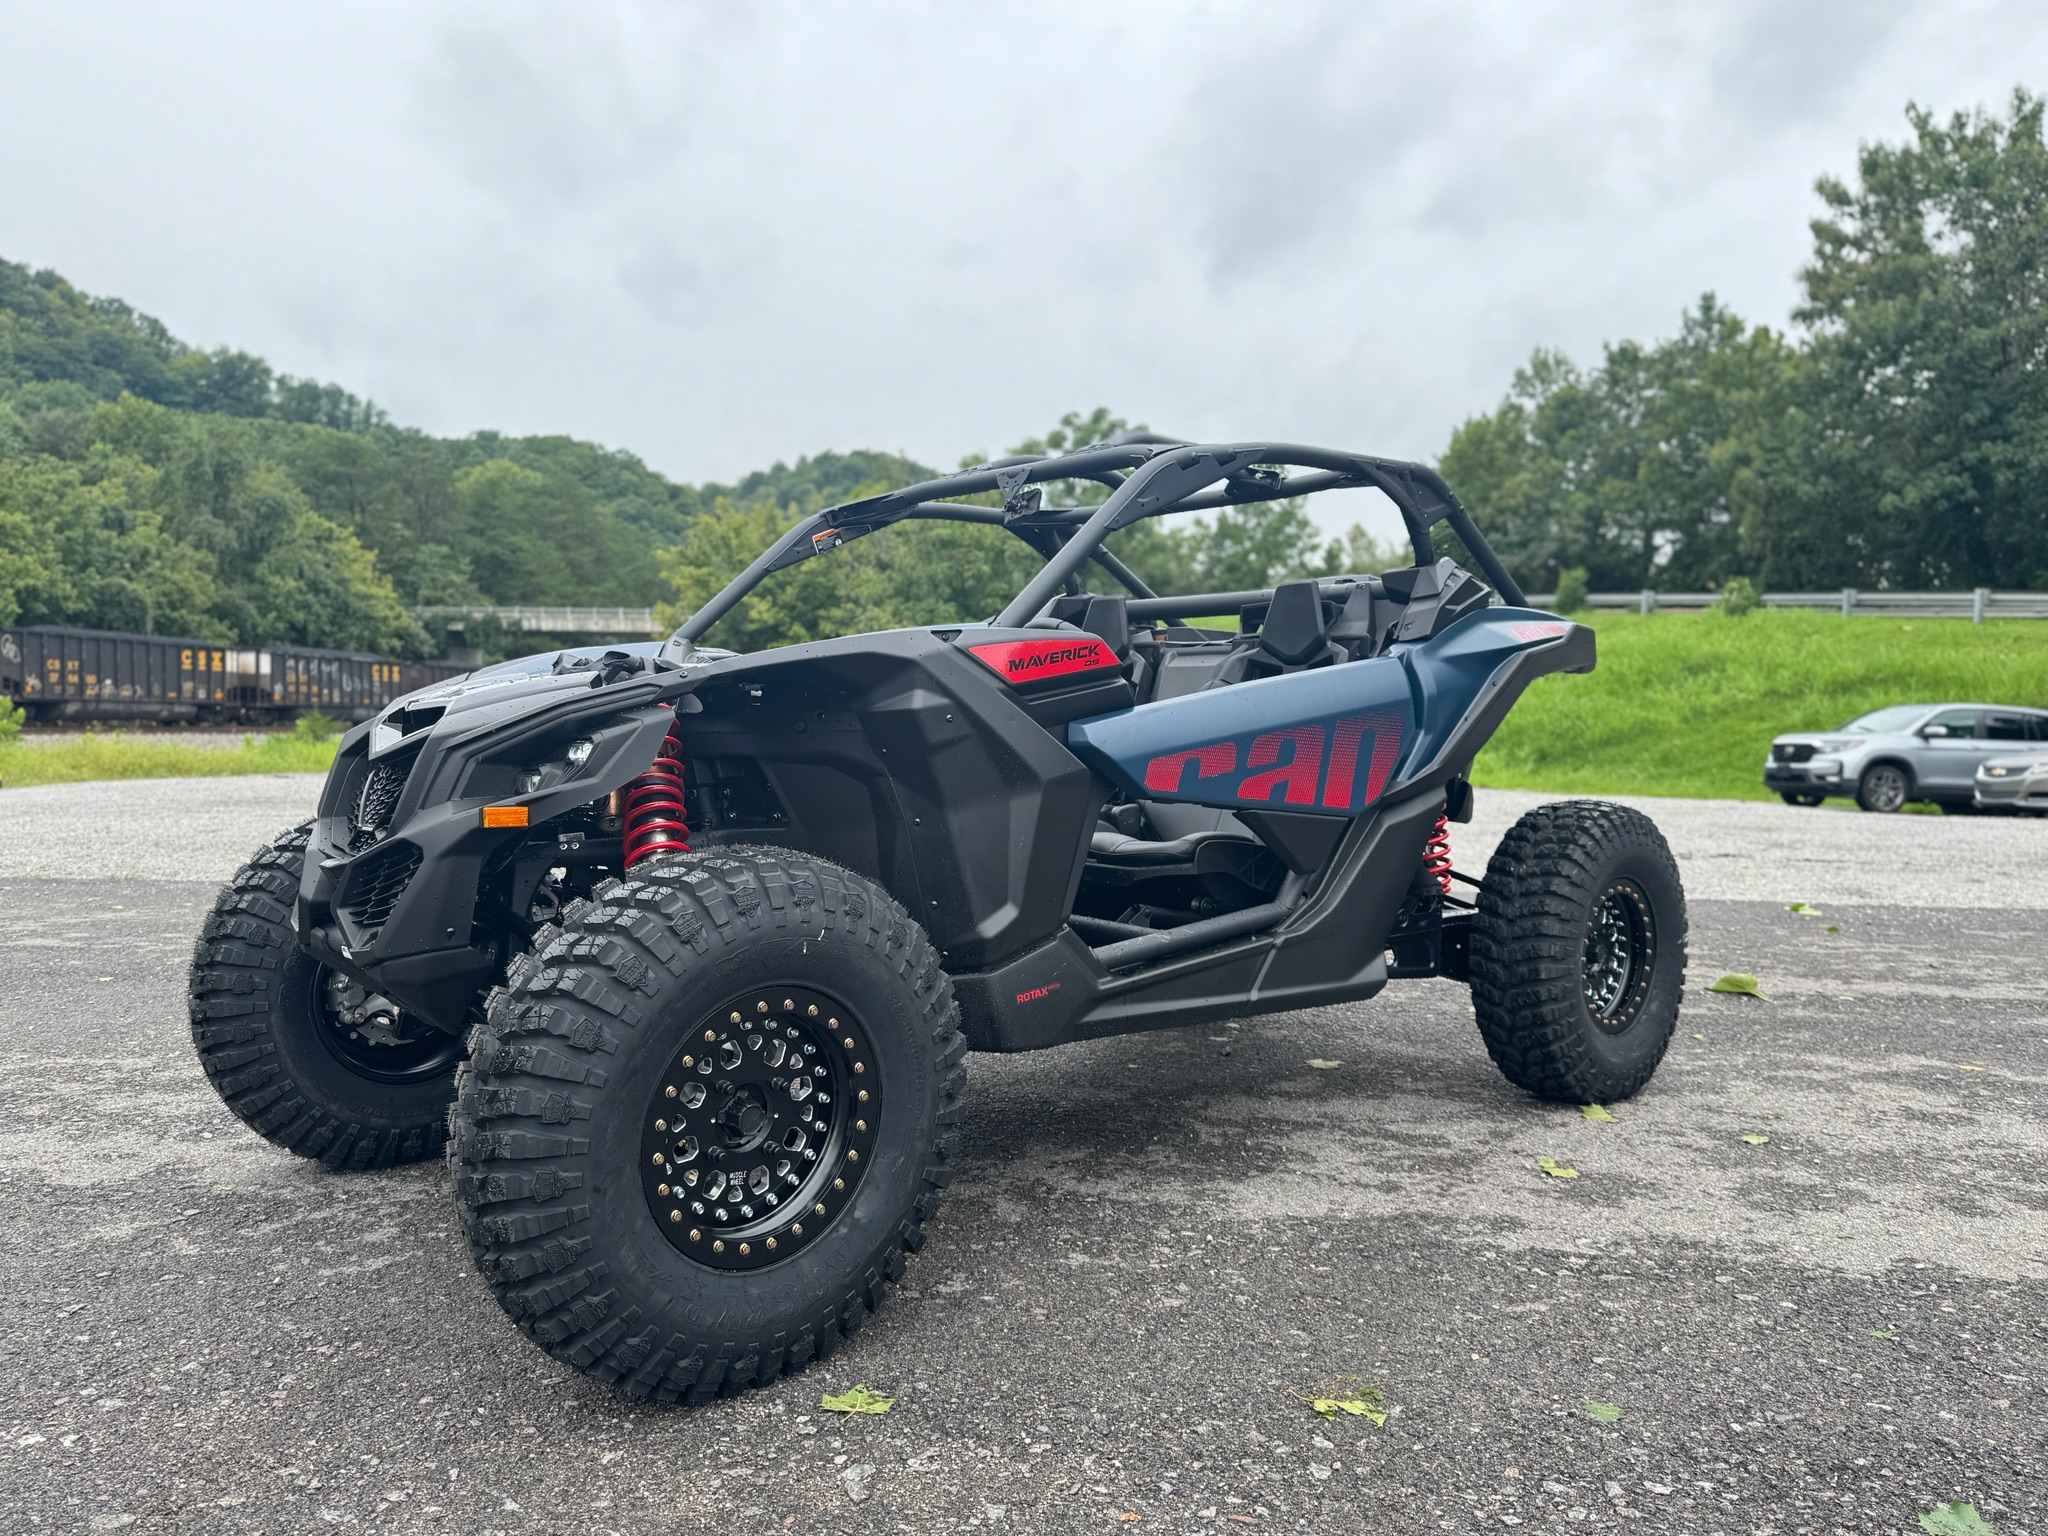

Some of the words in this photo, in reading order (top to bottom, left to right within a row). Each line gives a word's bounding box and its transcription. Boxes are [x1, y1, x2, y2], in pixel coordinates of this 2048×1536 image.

[181, 649, 223, 672] CSX
[1008, 643, 1101, 673] MAVERICK
[1084, 658, 1100, 667] DS
[1016, 986, 1049, 1004] ROTAX
